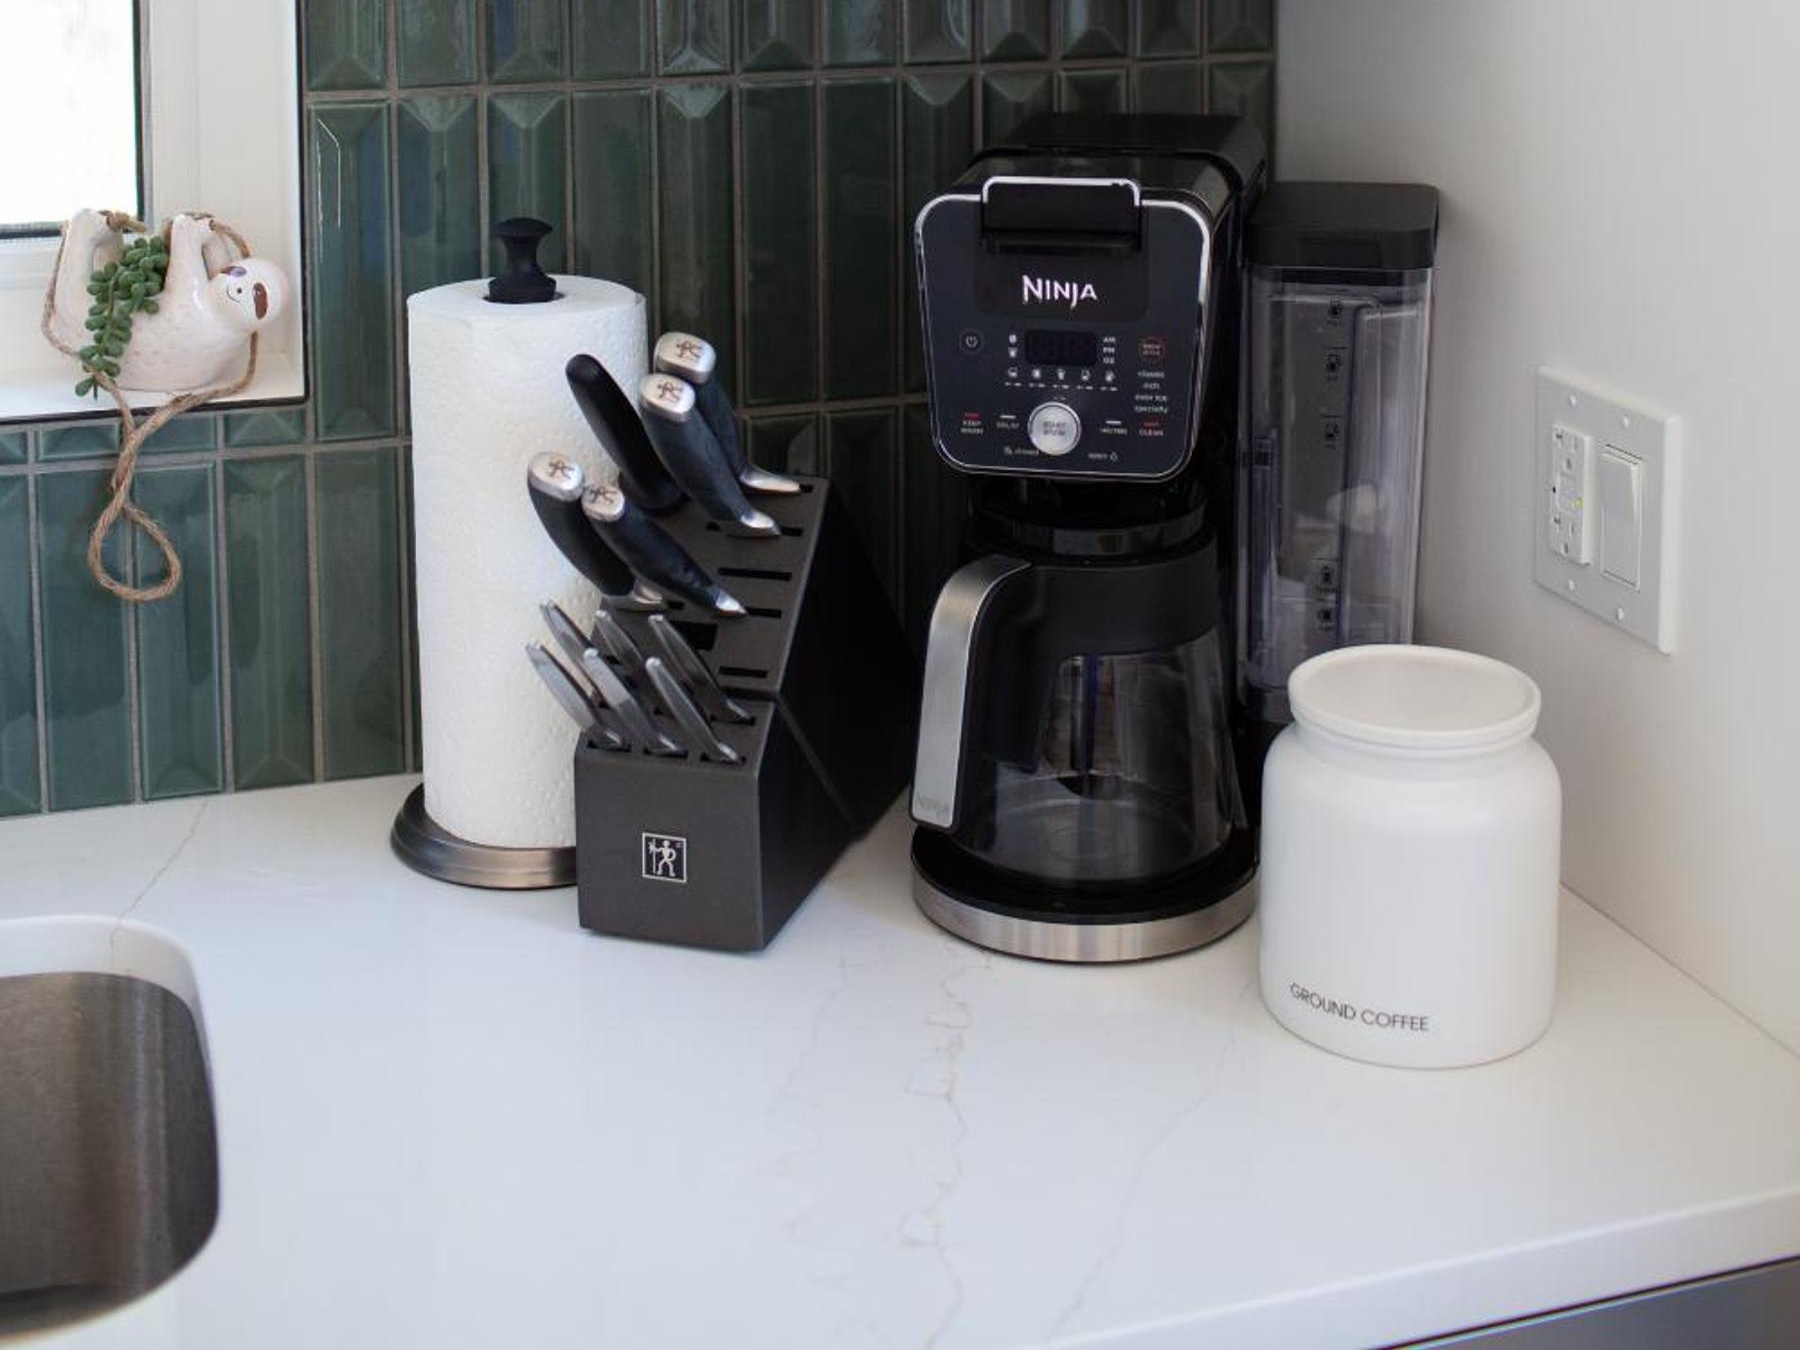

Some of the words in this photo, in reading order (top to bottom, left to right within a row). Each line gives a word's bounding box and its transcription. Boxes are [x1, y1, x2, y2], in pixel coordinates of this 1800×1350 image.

[1022, 275, 1098, 310] NINJA
[1289, 982, 1356, 1020] GROUND
[1360, 1009, 1430, 1031] COFFEE
